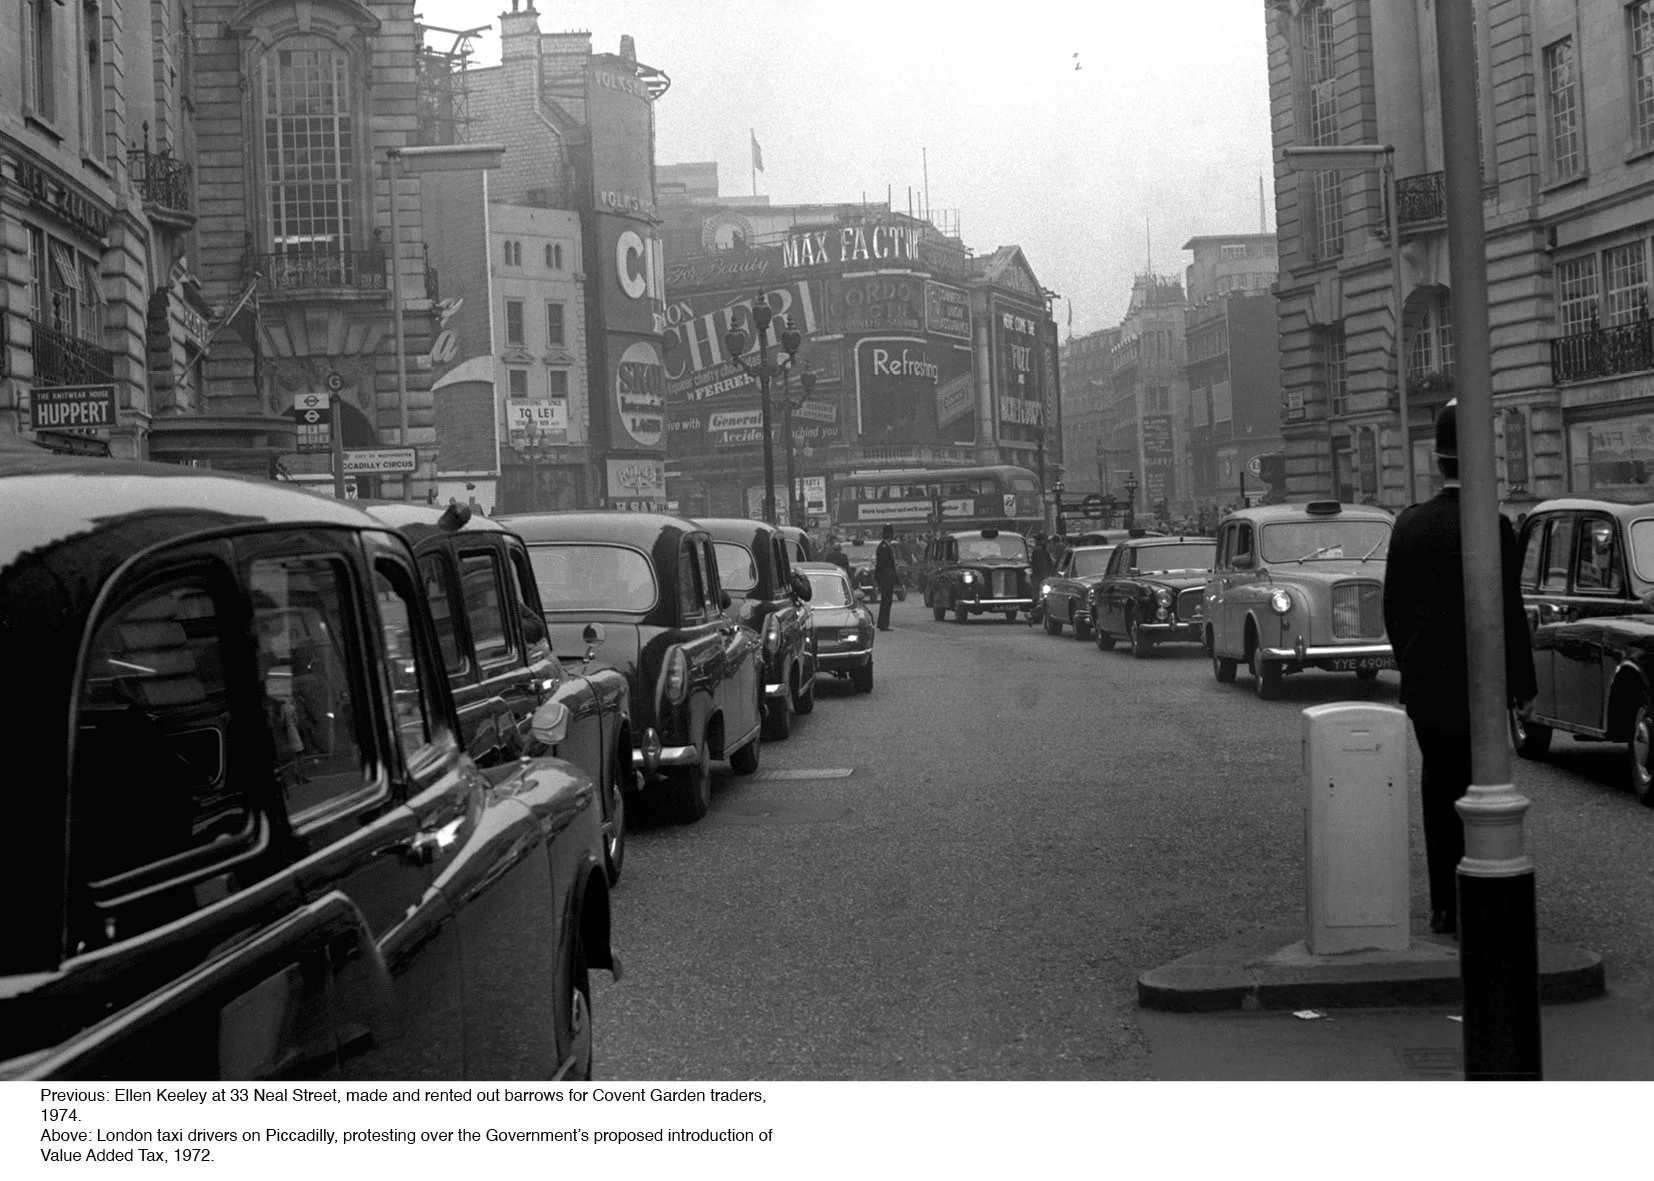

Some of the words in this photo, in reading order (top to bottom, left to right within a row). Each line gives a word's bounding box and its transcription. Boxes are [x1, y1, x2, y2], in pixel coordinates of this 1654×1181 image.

[707, 256, 770, 280] Beauty
[782, 232, 831, 268] MAX
[873, 348, 938, 385] Refreshing
[329, 375, 341, 388] G
[695, 371, 756, 400] FERRER
[37, 400, 109, 425] HUPPERT
[519, 408, 532, 418] TO
[537, 408, 555, 418] LET
[682, 418, 701, 430] with
[711, 414, 761, 428] General
[718, 429, 777, 442] Accidet
[821, 427, 838, 440] you
[343, 462, 380, 470] CCADILLY
[1332, 658, 1357, 669] YYE
